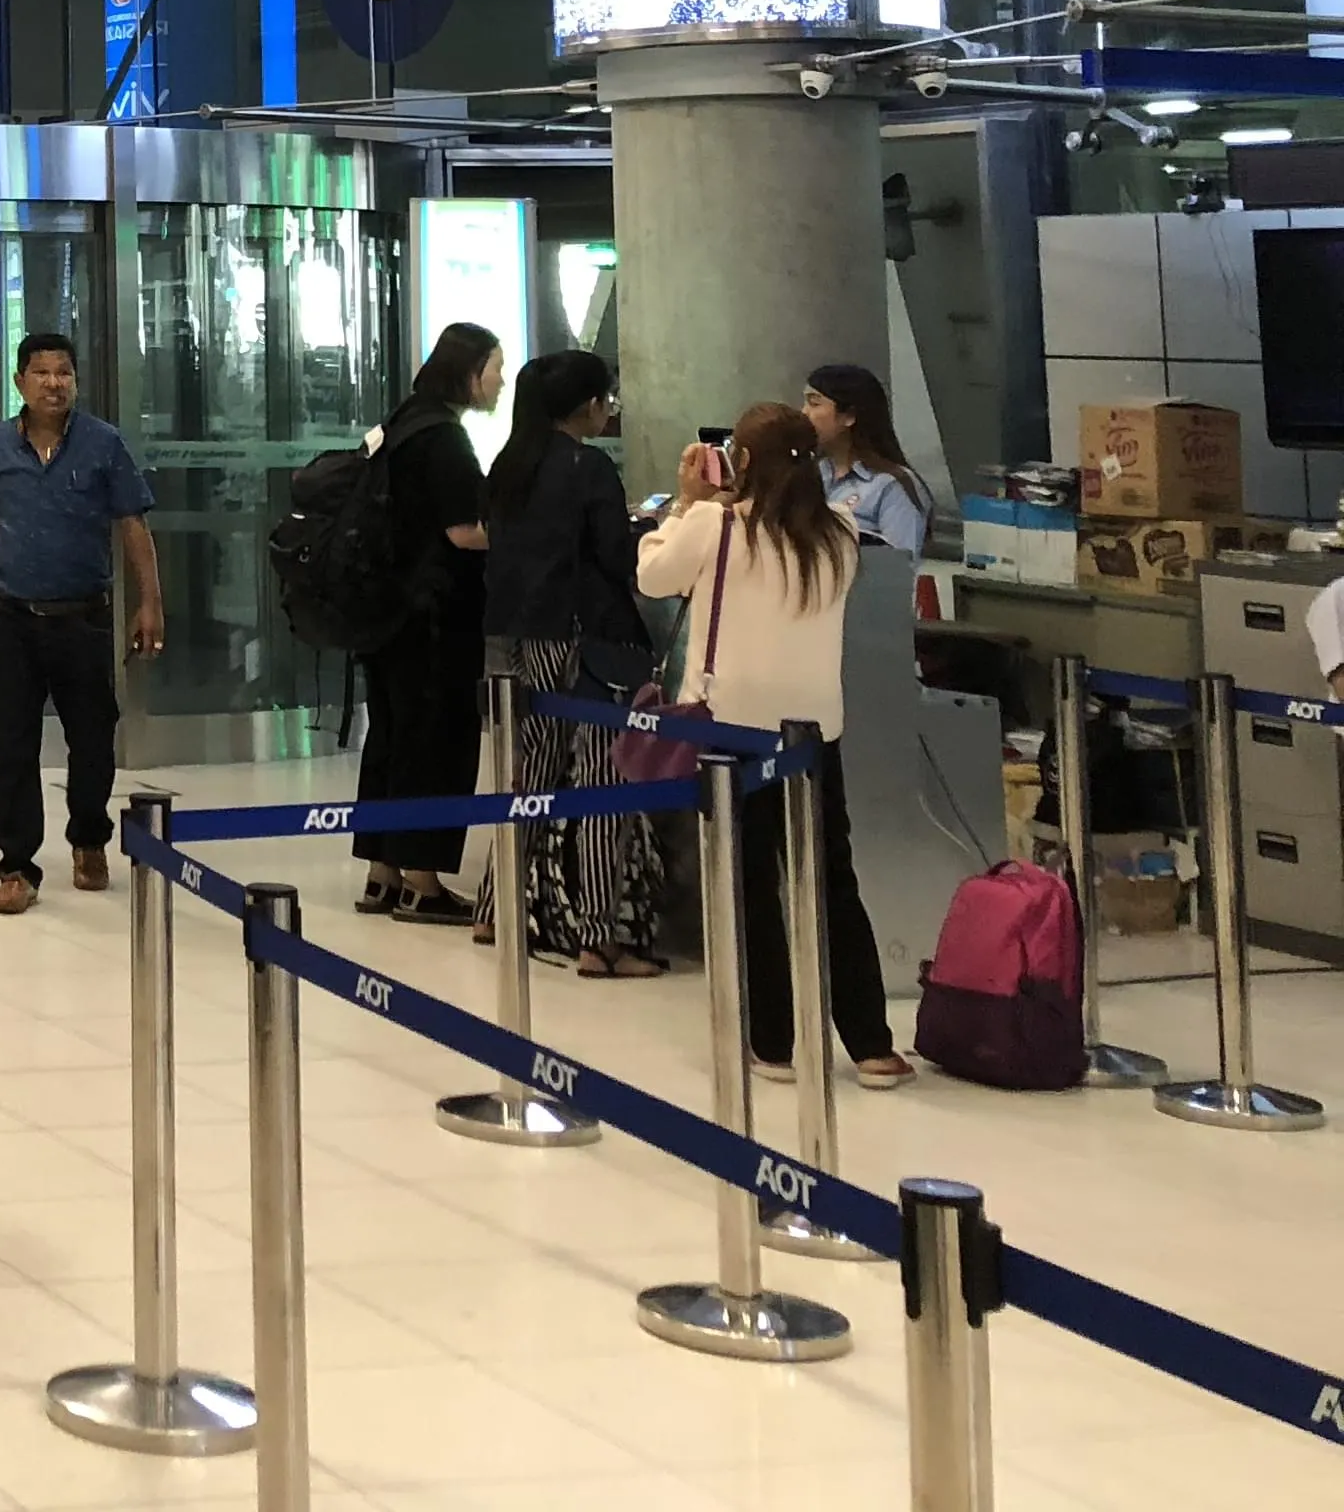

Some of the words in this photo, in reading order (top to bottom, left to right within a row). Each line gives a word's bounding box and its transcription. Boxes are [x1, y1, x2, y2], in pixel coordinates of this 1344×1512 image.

[626, 710, 660, 732] AOT
[1287, 699, 1325, 721] AOT
[303, 806, 354, 830] AOT
[508, 794, 555, 819] AOT
[180, 860, 204, 892] AOT
[354, 973, 394, 1012] AOT
[531, 1050, 579, 1098] AOT
[755, 1154, 818, 1210] AOT
